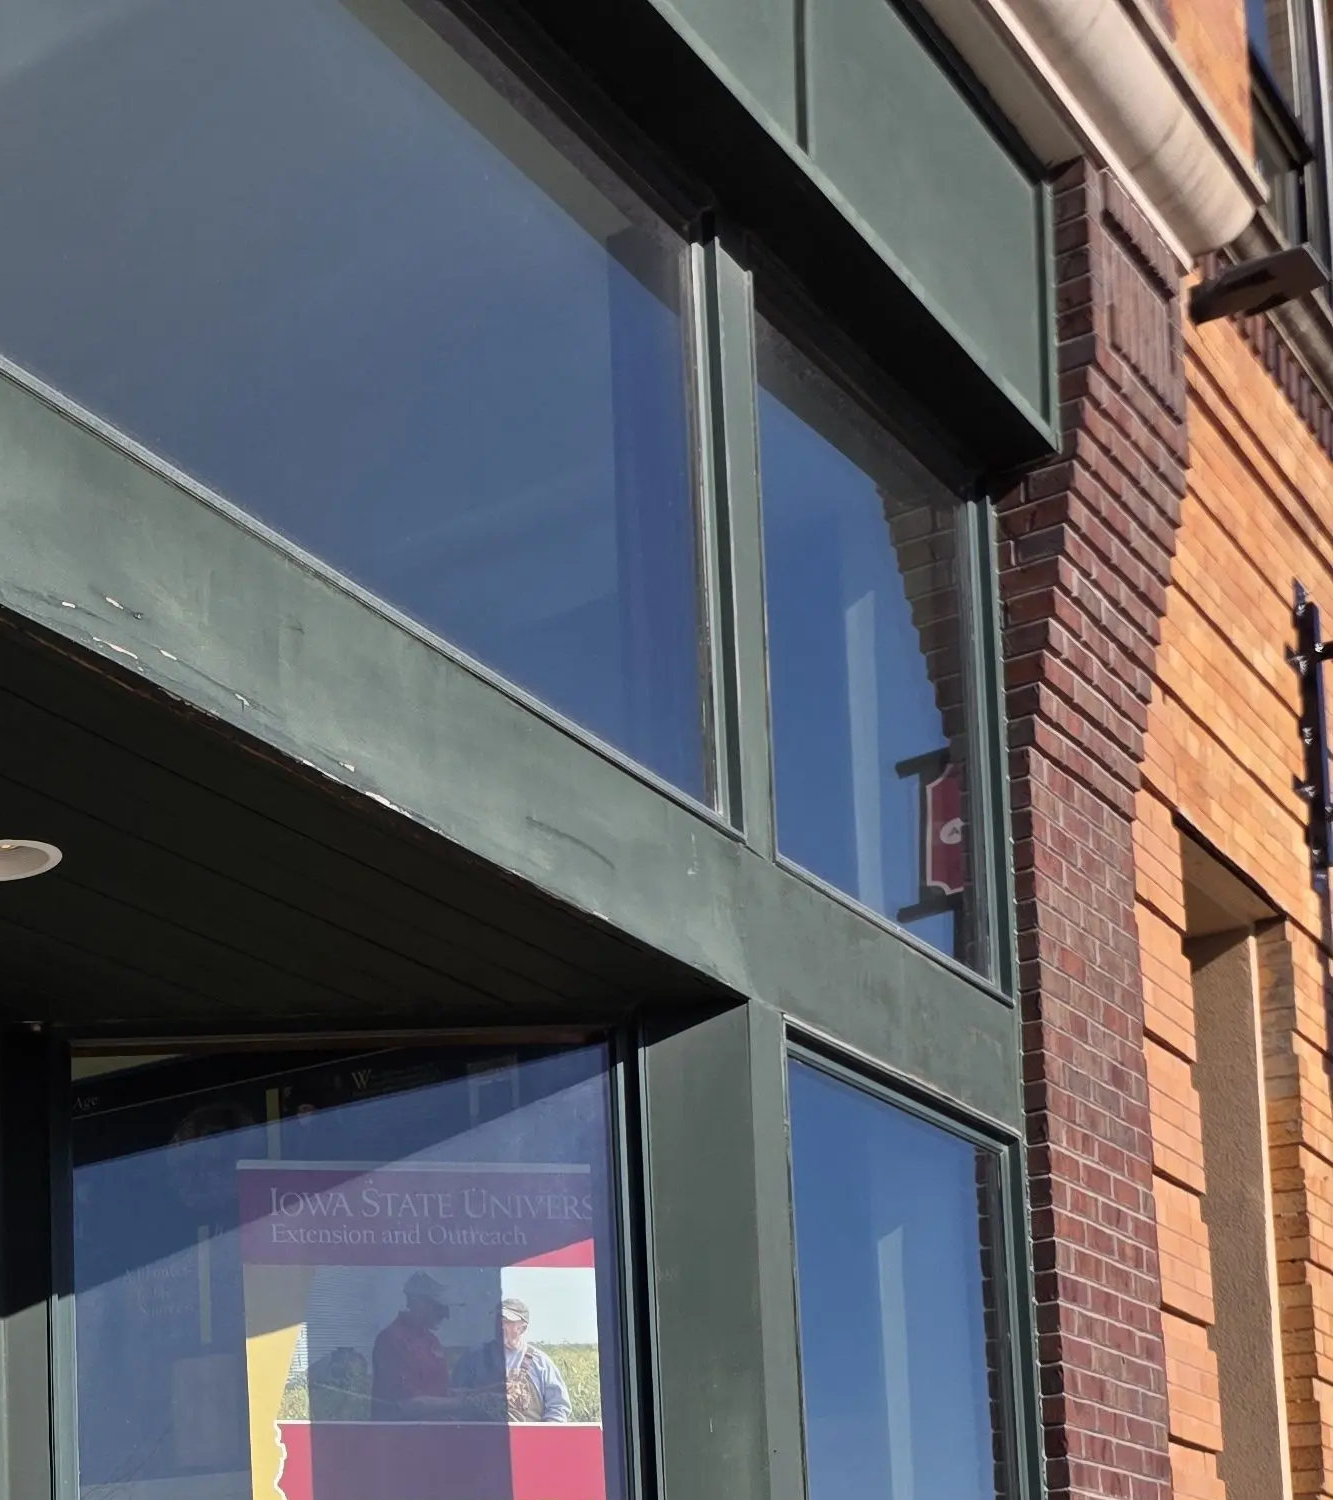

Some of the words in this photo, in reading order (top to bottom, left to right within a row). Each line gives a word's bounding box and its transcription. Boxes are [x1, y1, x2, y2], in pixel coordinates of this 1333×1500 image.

[269, 1187, 355, 1219] IOWA
[361, 1187, 454, 1219] STATE
[271, 1223, 376, 1245] Extension
[382, 1225, 422, 1246] and
[427, 1225, 528, 1247] Outreach
